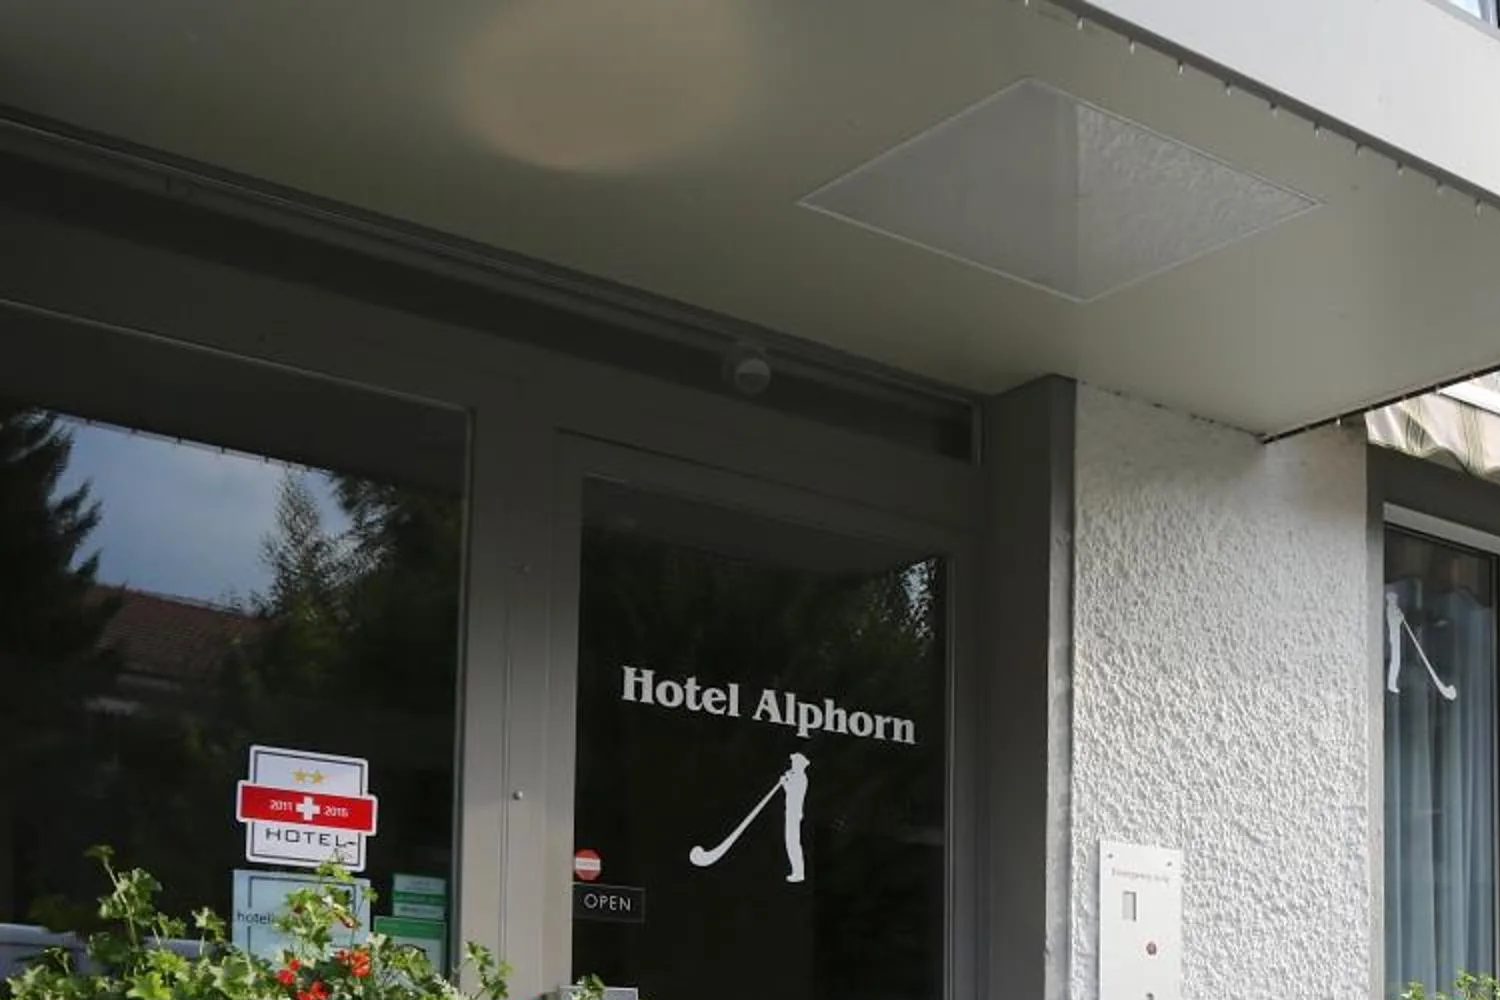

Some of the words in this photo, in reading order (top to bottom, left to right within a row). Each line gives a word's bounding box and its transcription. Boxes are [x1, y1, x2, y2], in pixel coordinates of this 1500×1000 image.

[621, 665, 741, 717] Hotel
[752, 688, 917, 745] Alphorn
[269, 800, 293, 812] 2011
[265, 828, 346, 847] HOTEL
[583, 893, 631, 911] OPEN
